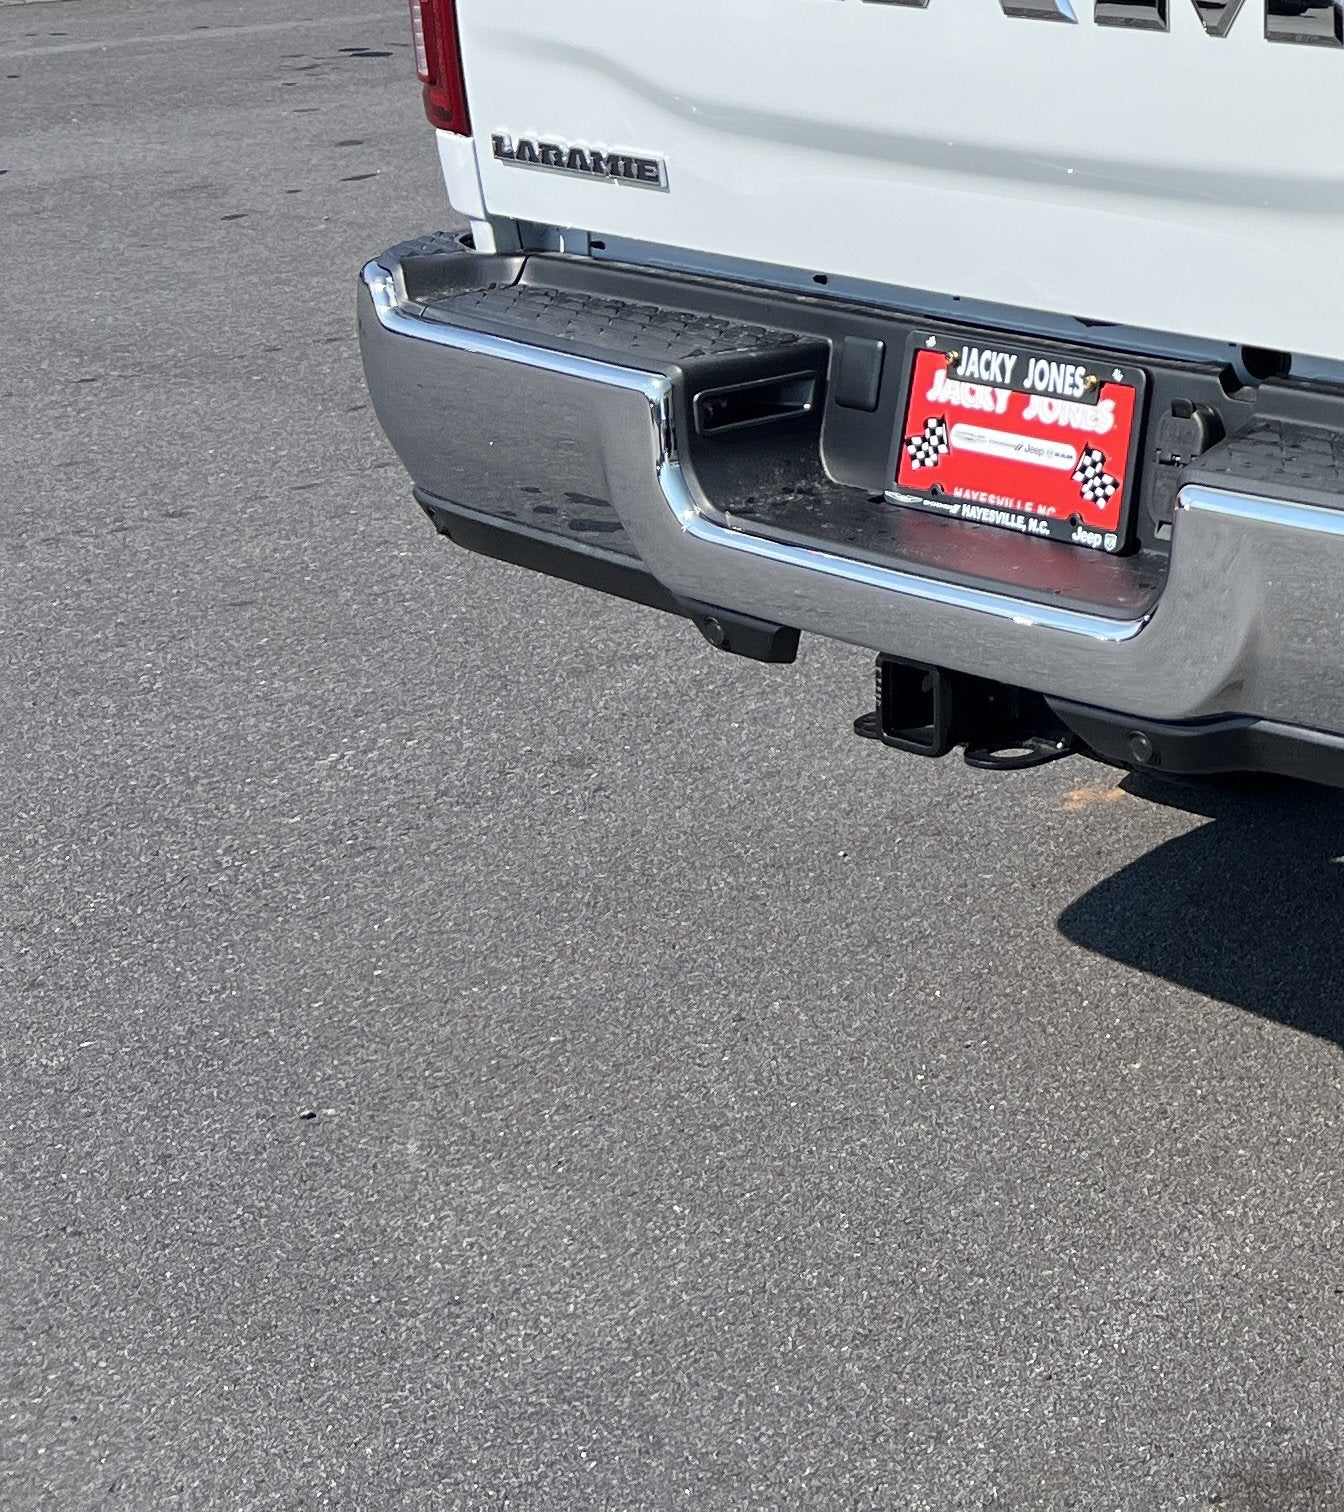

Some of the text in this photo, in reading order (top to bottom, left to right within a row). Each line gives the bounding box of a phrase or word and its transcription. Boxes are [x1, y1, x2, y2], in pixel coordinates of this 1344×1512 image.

[491, 133, 669, 190] LARAMIE
[957, 346, 1086, 398] JACKY JONES
[926, 369, 1012, 414] JACKY
[1022, 395, 1115, 435] JONES
[1024, 444, 1045, 457] Jeep
[961, 503, 1026, 532] HAYESVILLE,
[1029, 519, 1051, 535] N.C.
[1071, 526, 1103, 549] Jeep
